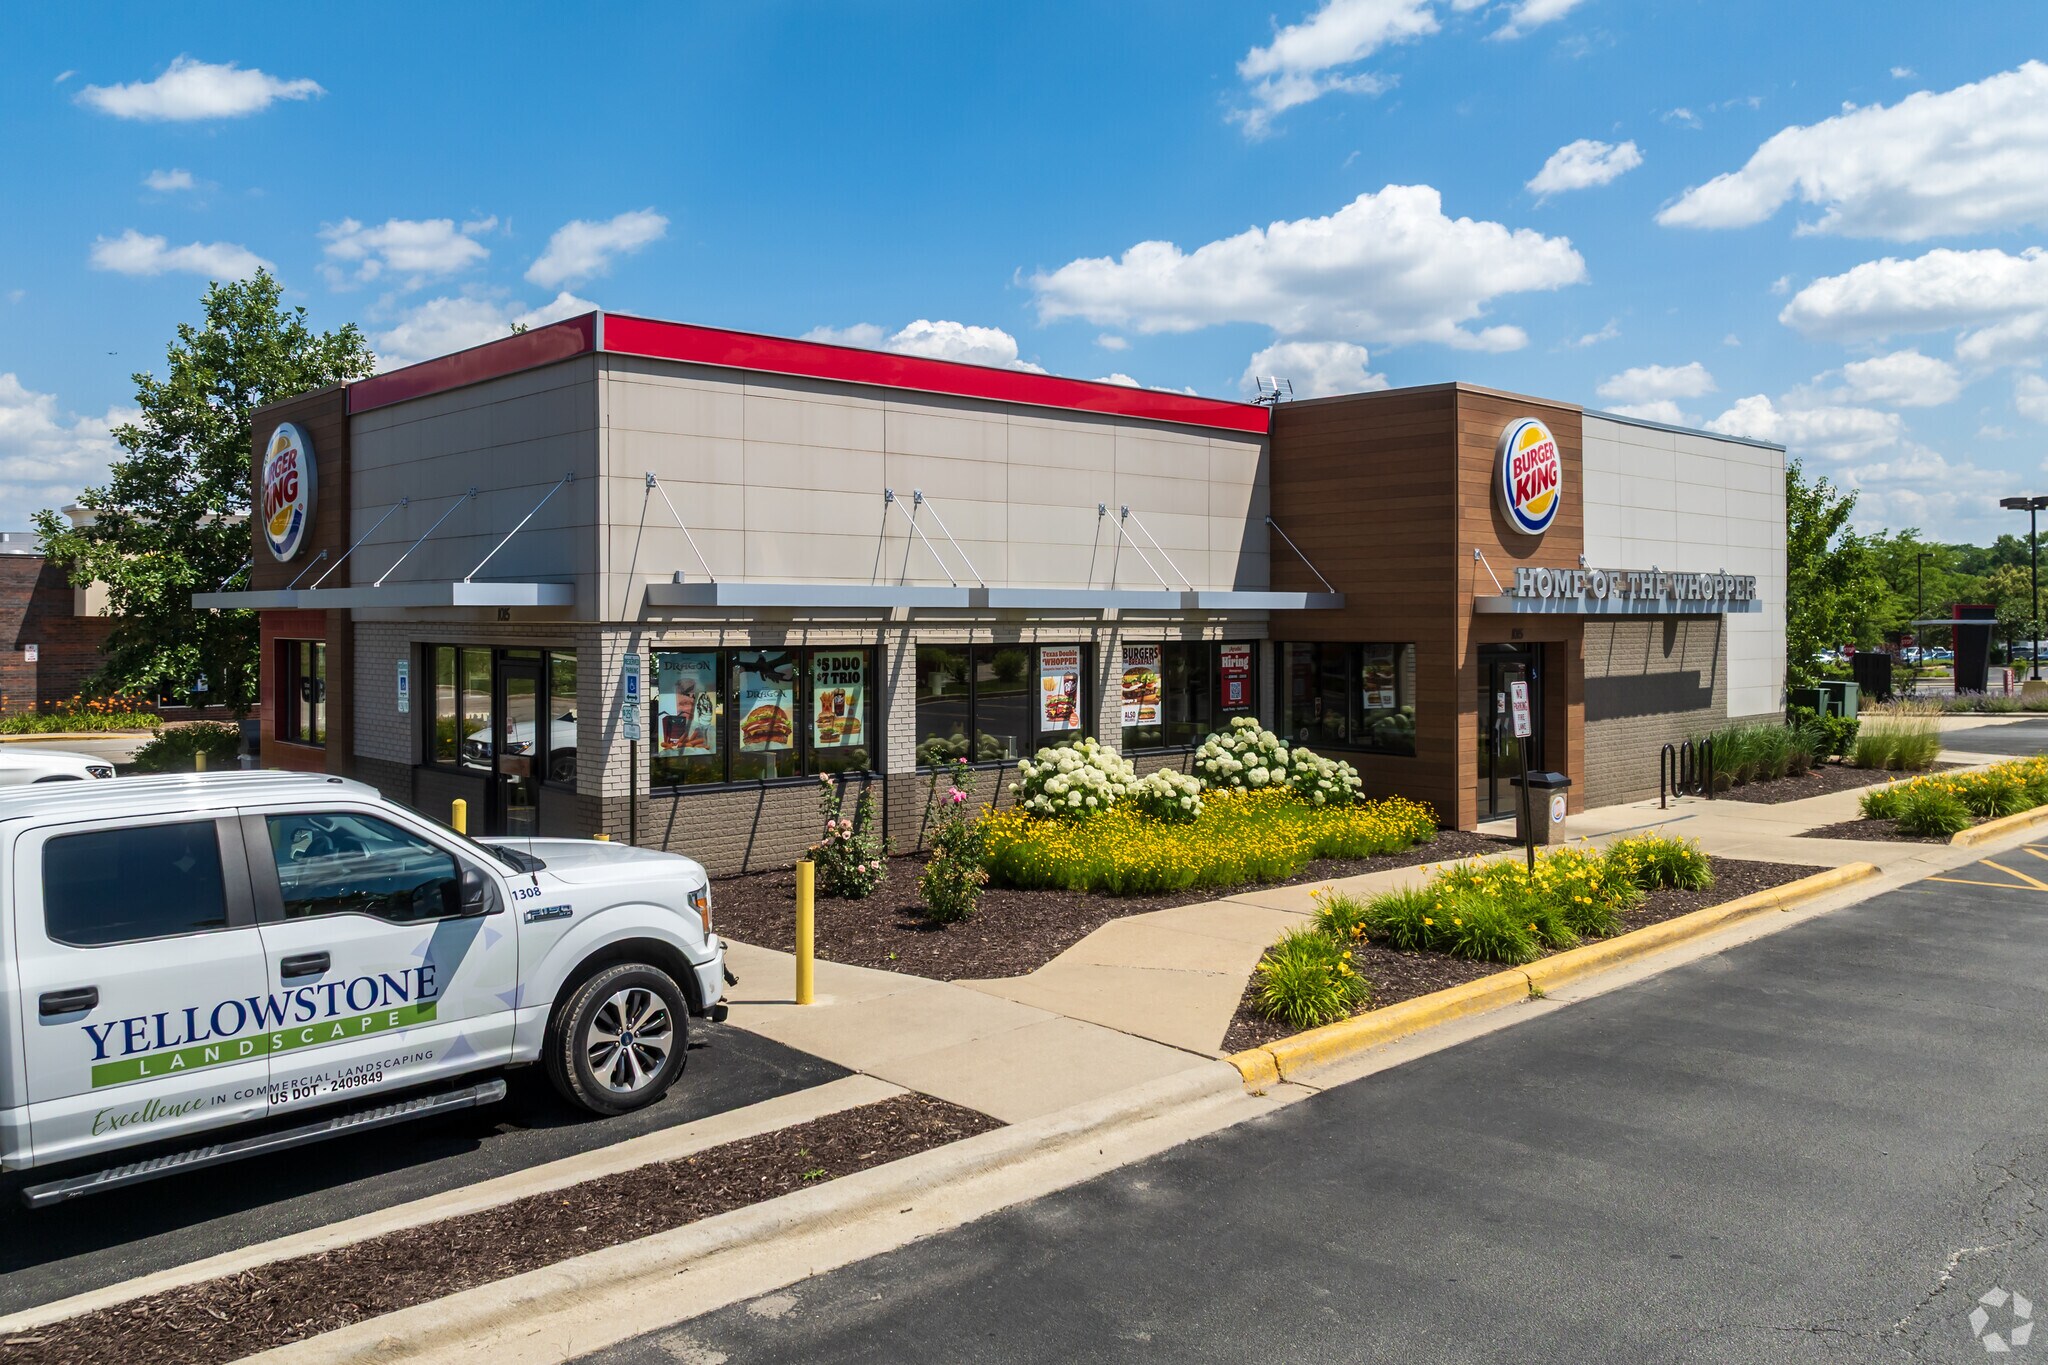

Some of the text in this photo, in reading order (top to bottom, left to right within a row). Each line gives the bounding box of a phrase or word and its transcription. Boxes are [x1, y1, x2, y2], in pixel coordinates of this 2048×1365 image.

[265, 449, 298, 487] RGER
[1513, 442, 1555, 479] BURGER
[264, 471, 298, 523] KING
[1516, 461, 1557, 508] KING
[1516, 567, 1757, 600] HOME OF THE WHOPPER
[664, 661, 711, 671] DRAGON
[817, 657, 860, 671] $5 DUO
[1123, 648, 1158, 659] BURGERS
[1222, 655, 1249, 670] Hiring
[746, 689, 787, 699] DRAGON
[817, 671, 860, 684] $7 TRIO
[512, 887, 541, 900] 1308
[82, 965, 439, 1061] YELLOWSTONE
[140, 1011, 400, 1075] LANDSCAPE
[92, 1051, 433, 1137] Excellence IN COMMERCIAL LANDSCAPING
[270, 1092, 288, 1105] US
[292, 1084, 319, 1100] DOT
[331, 1071, 383, 1092] 2409849
